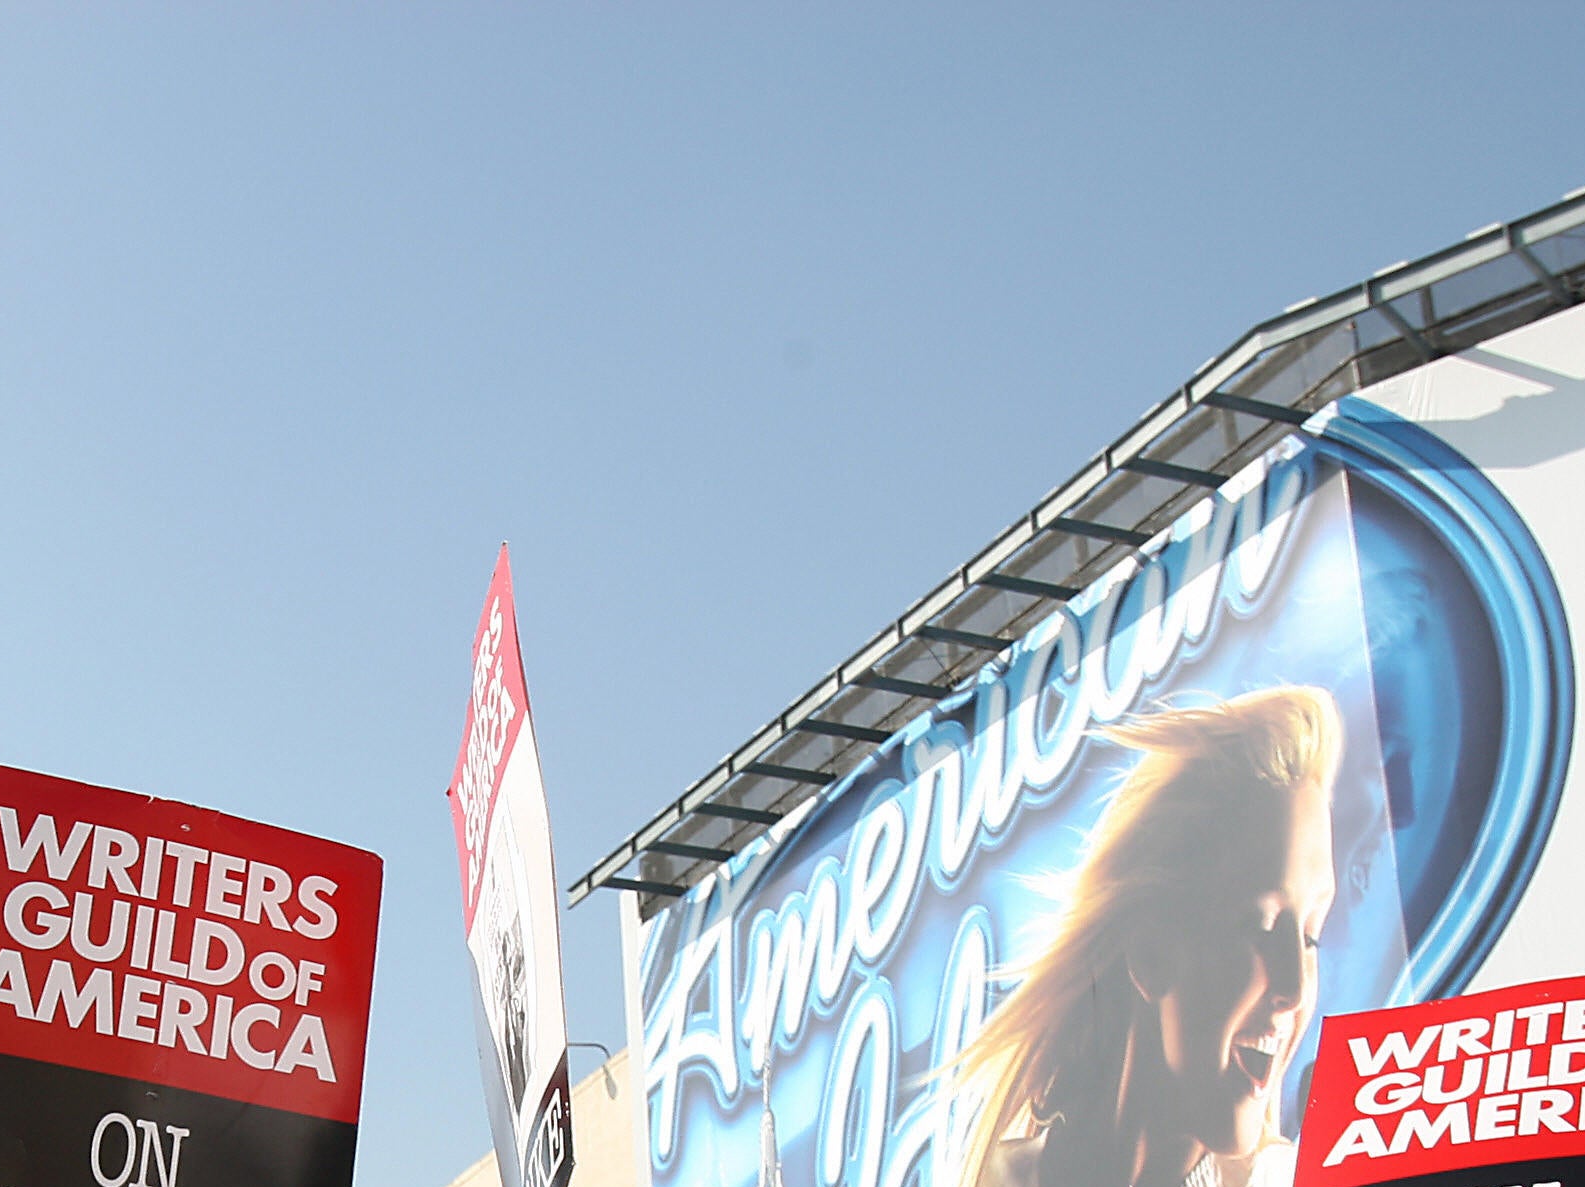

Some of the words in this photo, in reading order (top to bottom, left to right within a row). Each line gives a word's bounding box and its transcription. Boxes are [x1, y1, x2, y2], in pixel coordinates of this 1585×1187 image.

[3, 881, 246, 987] GUILD
[248, 950, 326, 1007] OF
[1353, 1040, 1585, 1117] GUILD
